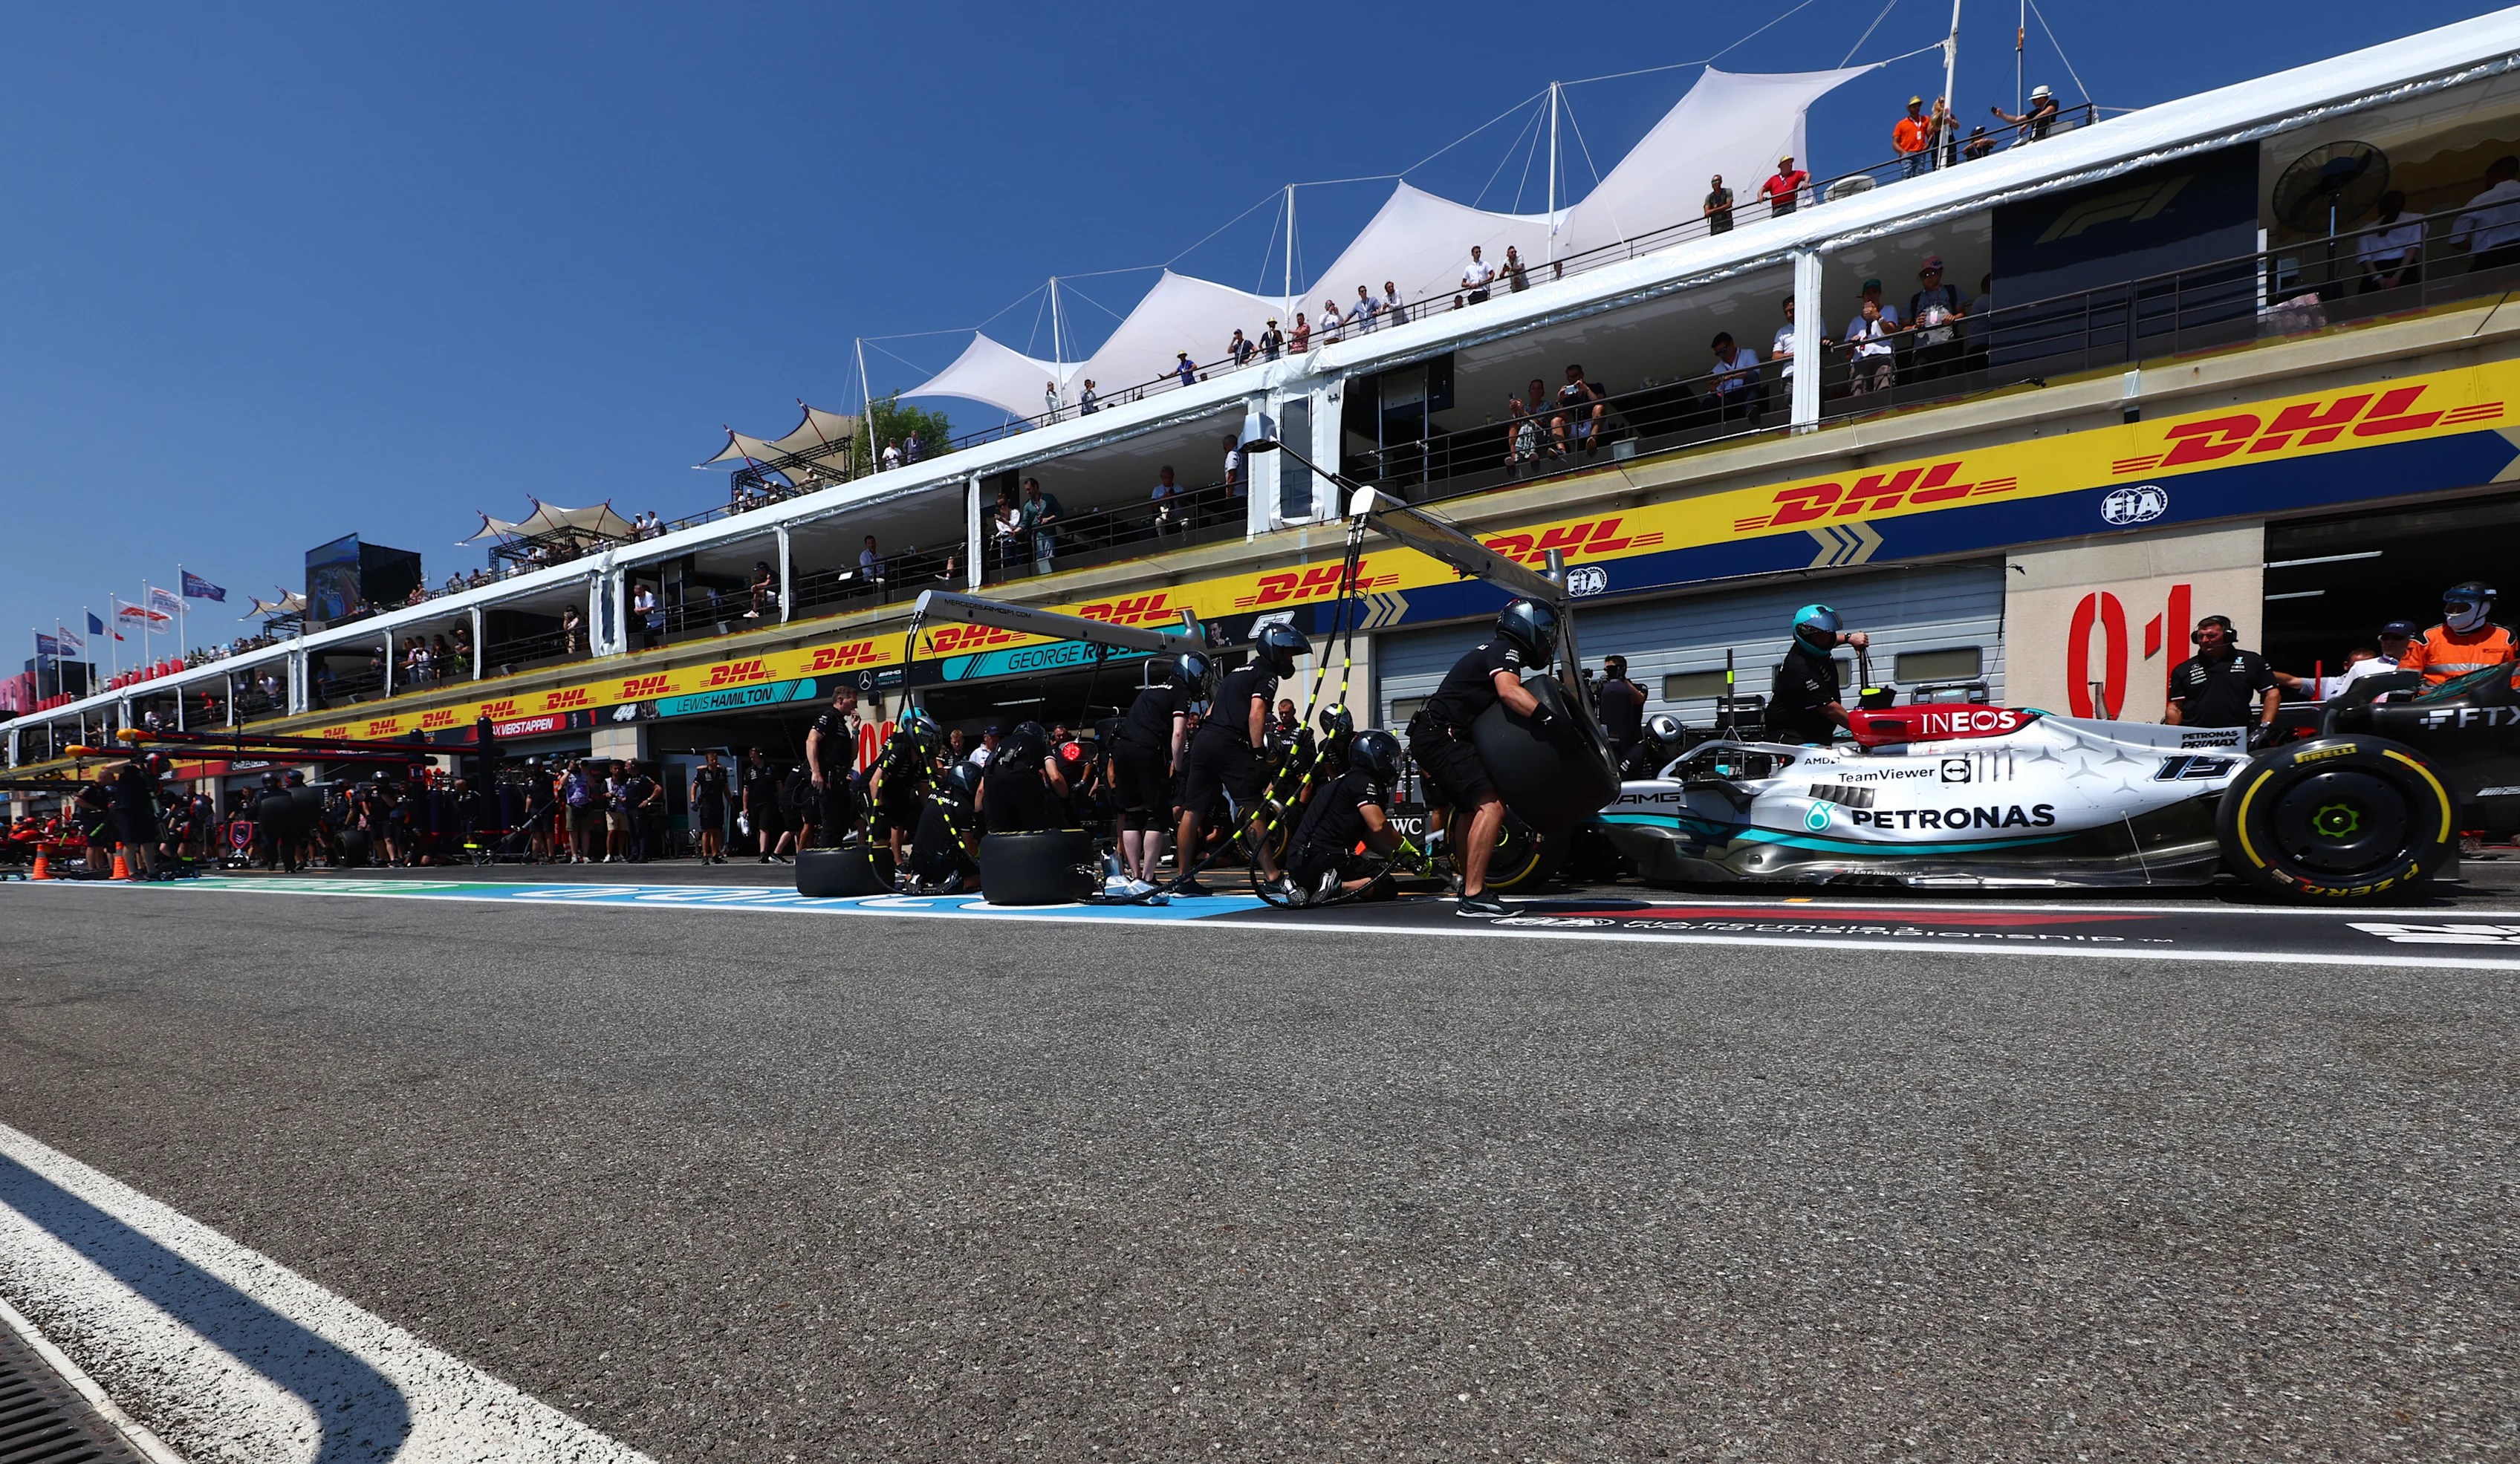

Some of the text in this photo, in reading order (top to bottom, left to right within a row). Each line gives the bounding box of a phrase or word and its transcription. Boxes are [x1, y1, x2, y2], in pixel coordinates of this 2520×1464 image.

[2160, 384, 2444, 467] DHL
[1769, 461, 1975, 527] DHL
[1484, 518, 1633, 563] DHL
[1256, 561, 1375, 605] DHL
[1079, 593, 1174, 625] DHL
[933, 625, 1011, 652] DHL
[812, 642, 877, 670] DHL
[1009, 646, 1079, 669] GEORGE
[2068, 585, 2191, 720] 01
[710, 660, 765, 686] DHL
[623, 675, 670, 698] DHL
[481, 700, 516, 719] DHL
[547, 689, 588, 709] DHL
[677, 688, 772, 712] LEWIS HAMILTON
[422, 710, 454, 728] DHL
[501, 718, 553, 735] VERSTAPPEN
[589, 709, 596, 725] 1
[612, 703, 637, 721] 44
[1921, 710, 2016, 735] INEOS
[2458, 706, 2520, 729] FTX
[322, 726, 348, 740] DHL
[369, 719, 398, 736] DHL
[2182, 730, 2238, 741] PETRONAS
[2180, 736, 2241, 749] PRIMAX
[2294, 743, 2357, 764] PIRELLI
[1805, 757, 1829, 765] AMD
[1839, 769, 1935, 784] TeamViewer
[1617, 792, 1680, 805] AMG
[1386, 818, 1423, 835] WC
[1851, 804, 2056, 830] PETRONAS
